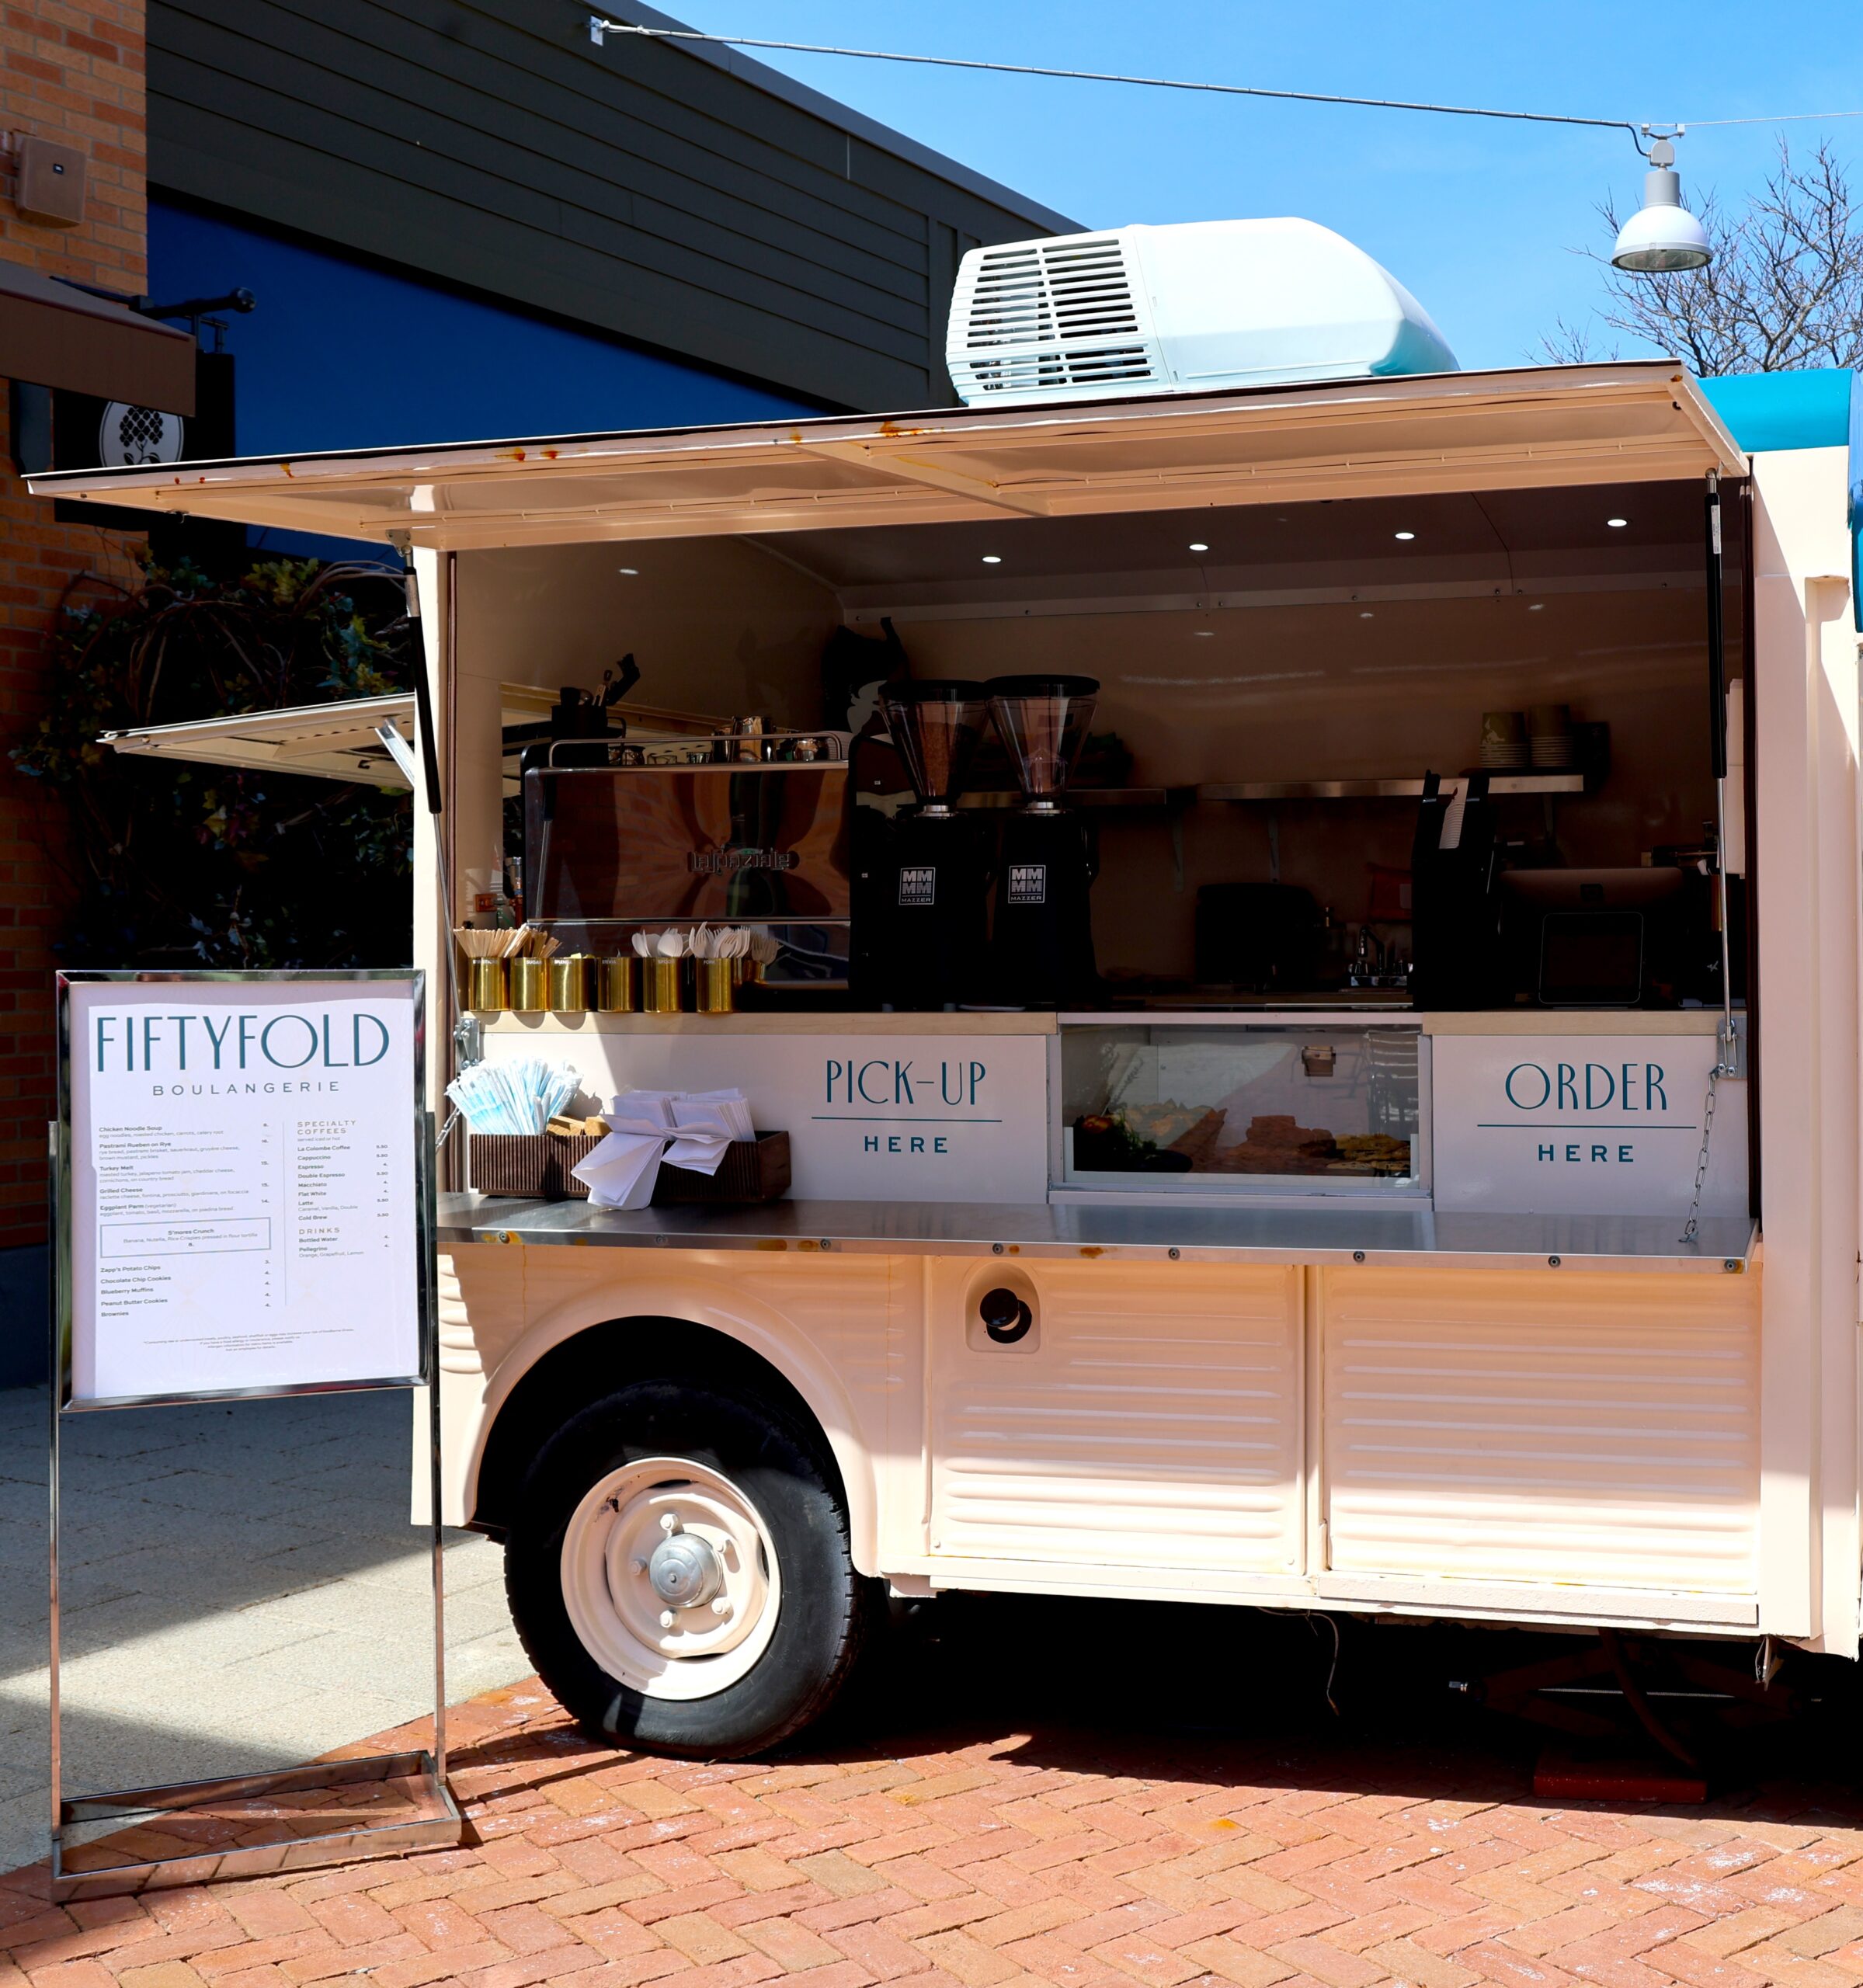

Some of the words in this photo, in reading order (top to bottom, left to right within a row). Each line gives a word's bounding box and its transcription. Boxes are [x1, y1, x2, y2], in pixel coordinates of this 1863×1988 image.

[97, 1013, 390, 1072] FIFTYFOLD
[152, 1081, 339, 1097] BOULANGERIE
[826, 1060, 986, 1106] PICK-UP
[1505, 1063, 1667, 1110] ORDER
[864, 1135, 948, 1154] HERE
[1538, 1144, 1634, 1163] HERE
